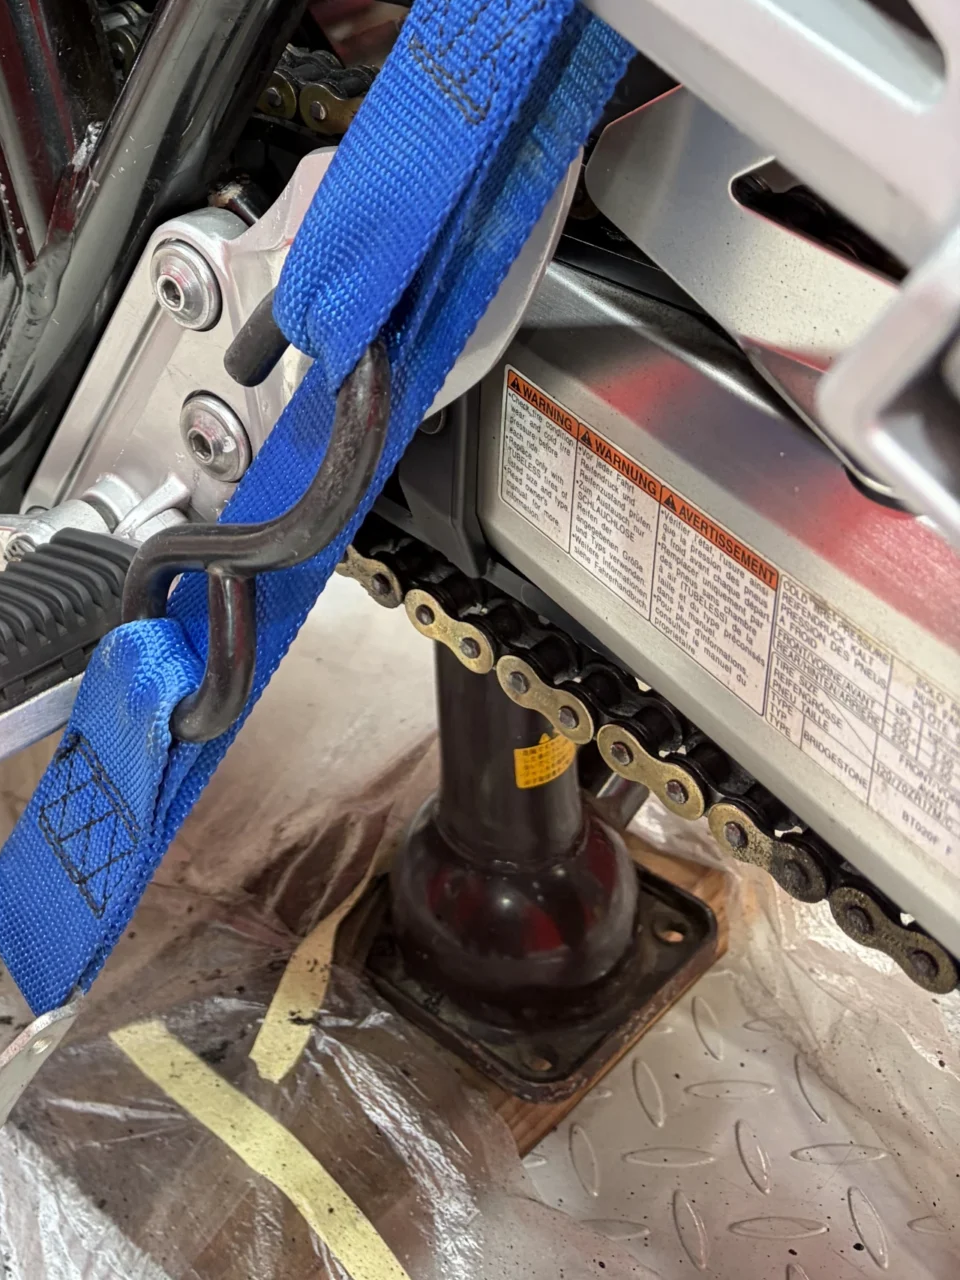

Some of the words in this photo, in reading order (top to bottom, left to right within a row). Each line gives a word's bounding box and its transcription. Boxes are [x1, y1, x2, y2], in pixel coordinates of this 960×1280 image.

[522, 382, 572, 433] WARNING
[528, 417, 541, 434] and
[543, 428, 557, 447] cold
[508, 434, 532, 462] Replace
[534, 455, 548, 475] only
[550, 468, 564, 486] with
[509, 413, 536, 443] pressure
[537, 435, 558, 459] before
[507, 444, 541, 480] TUBELESS
[560, 487, 568, 501] of
[539, 482, 552, 500] and
[578, 467, 626, 513] Reifenzustand
[579, 456, 619, 495] Reifendruck
[622, 489, 636, 508] und
[580, 446, 593, 463] Vor
[595, 456, 613, 480] jeder
[615, 472, 635, 496] Fahrt
[594, 436, 657, 498] WARNUNG
[575, 510, 619, 555] angegebenen
[576, 488, 636, 544] SCHLAUCHLOSE
[576, 499, 598, 526] Reifen
[600, 519, 613, 538] der
[578, 478, 593, 498] Zum
[595, 492, 630, 528] Austausch
[633, 522, 645, 539] nur
[574, 522, 588, 540] und
[589, 533, 607, 557] Typs
[662, 519, 676, 540] que
[678, 532, 687, 547] la
[689, 541, 722, 576] pression
[724, 568, 740, 588] des
[743, 583, 769, 612] pneus
[677, 499, 776, 589] AVERTISSEMENT
[574, 532, 599, 561] Weitere
[601, 555, 648, 601] Informationen
[659, 541, 699, 581] Remplacer
[701, 573, 747, 619] uniquement
[749, 612, 764, 632] par
[669, 536, 687, 558] froid
[688, 552, 710, 577] avant
[712, 570, 741, 603] chaque
[748, 574, 770, 599] ainsi
[782, 577, 809, 607] COLD
[655, 593, 672, 616] Pour
[674, 609, 691, 632] plus
[656, 583, 674, 606] dans
[676, 600, 685, 615] le
[657, 573, 675, 596] taille
[677, 590, 686, 605] et
[689, 598, 700, 615] du
[702, 609, 720, 634] type
[659, 552, 673, 571] des
[675, 566, 698, 592] pneus
[701, 586, 720, 608] sans
[722, 602, 757, 639] chambre
[666, 569, 677, 585] air
[730, 620, 742, 638] de
[745, 632, 754, 647] la
[654, 603, 689, 640] consulter
[691, 634, 700, 649] le
[703, 643, 732, 675] manuel
[735, 670, 747, 688] du
[779, 600, 826, 646] PRESSION
[829, 638, 850, 663] DES
[852, 655, 888, 692] PNEUS
[781, 589, 846, 649] REIFENDRUCK
[849, 640, 875, 669] KALT
[789, 620, 818, 651] FROID
[774, 654, 795, 680] TIRE
[798, 673, 819, 698] SIZE
[768, 711, 791, 739] TYPE
[769, 689, 793, 717] TYPE
[769, 700, 787, 724] TYP
[771, 677, 797, 706] PNEU
[799, 699, 830, 732] TAILLE
[802, 728, 868, 791] BRIDGESTONE
